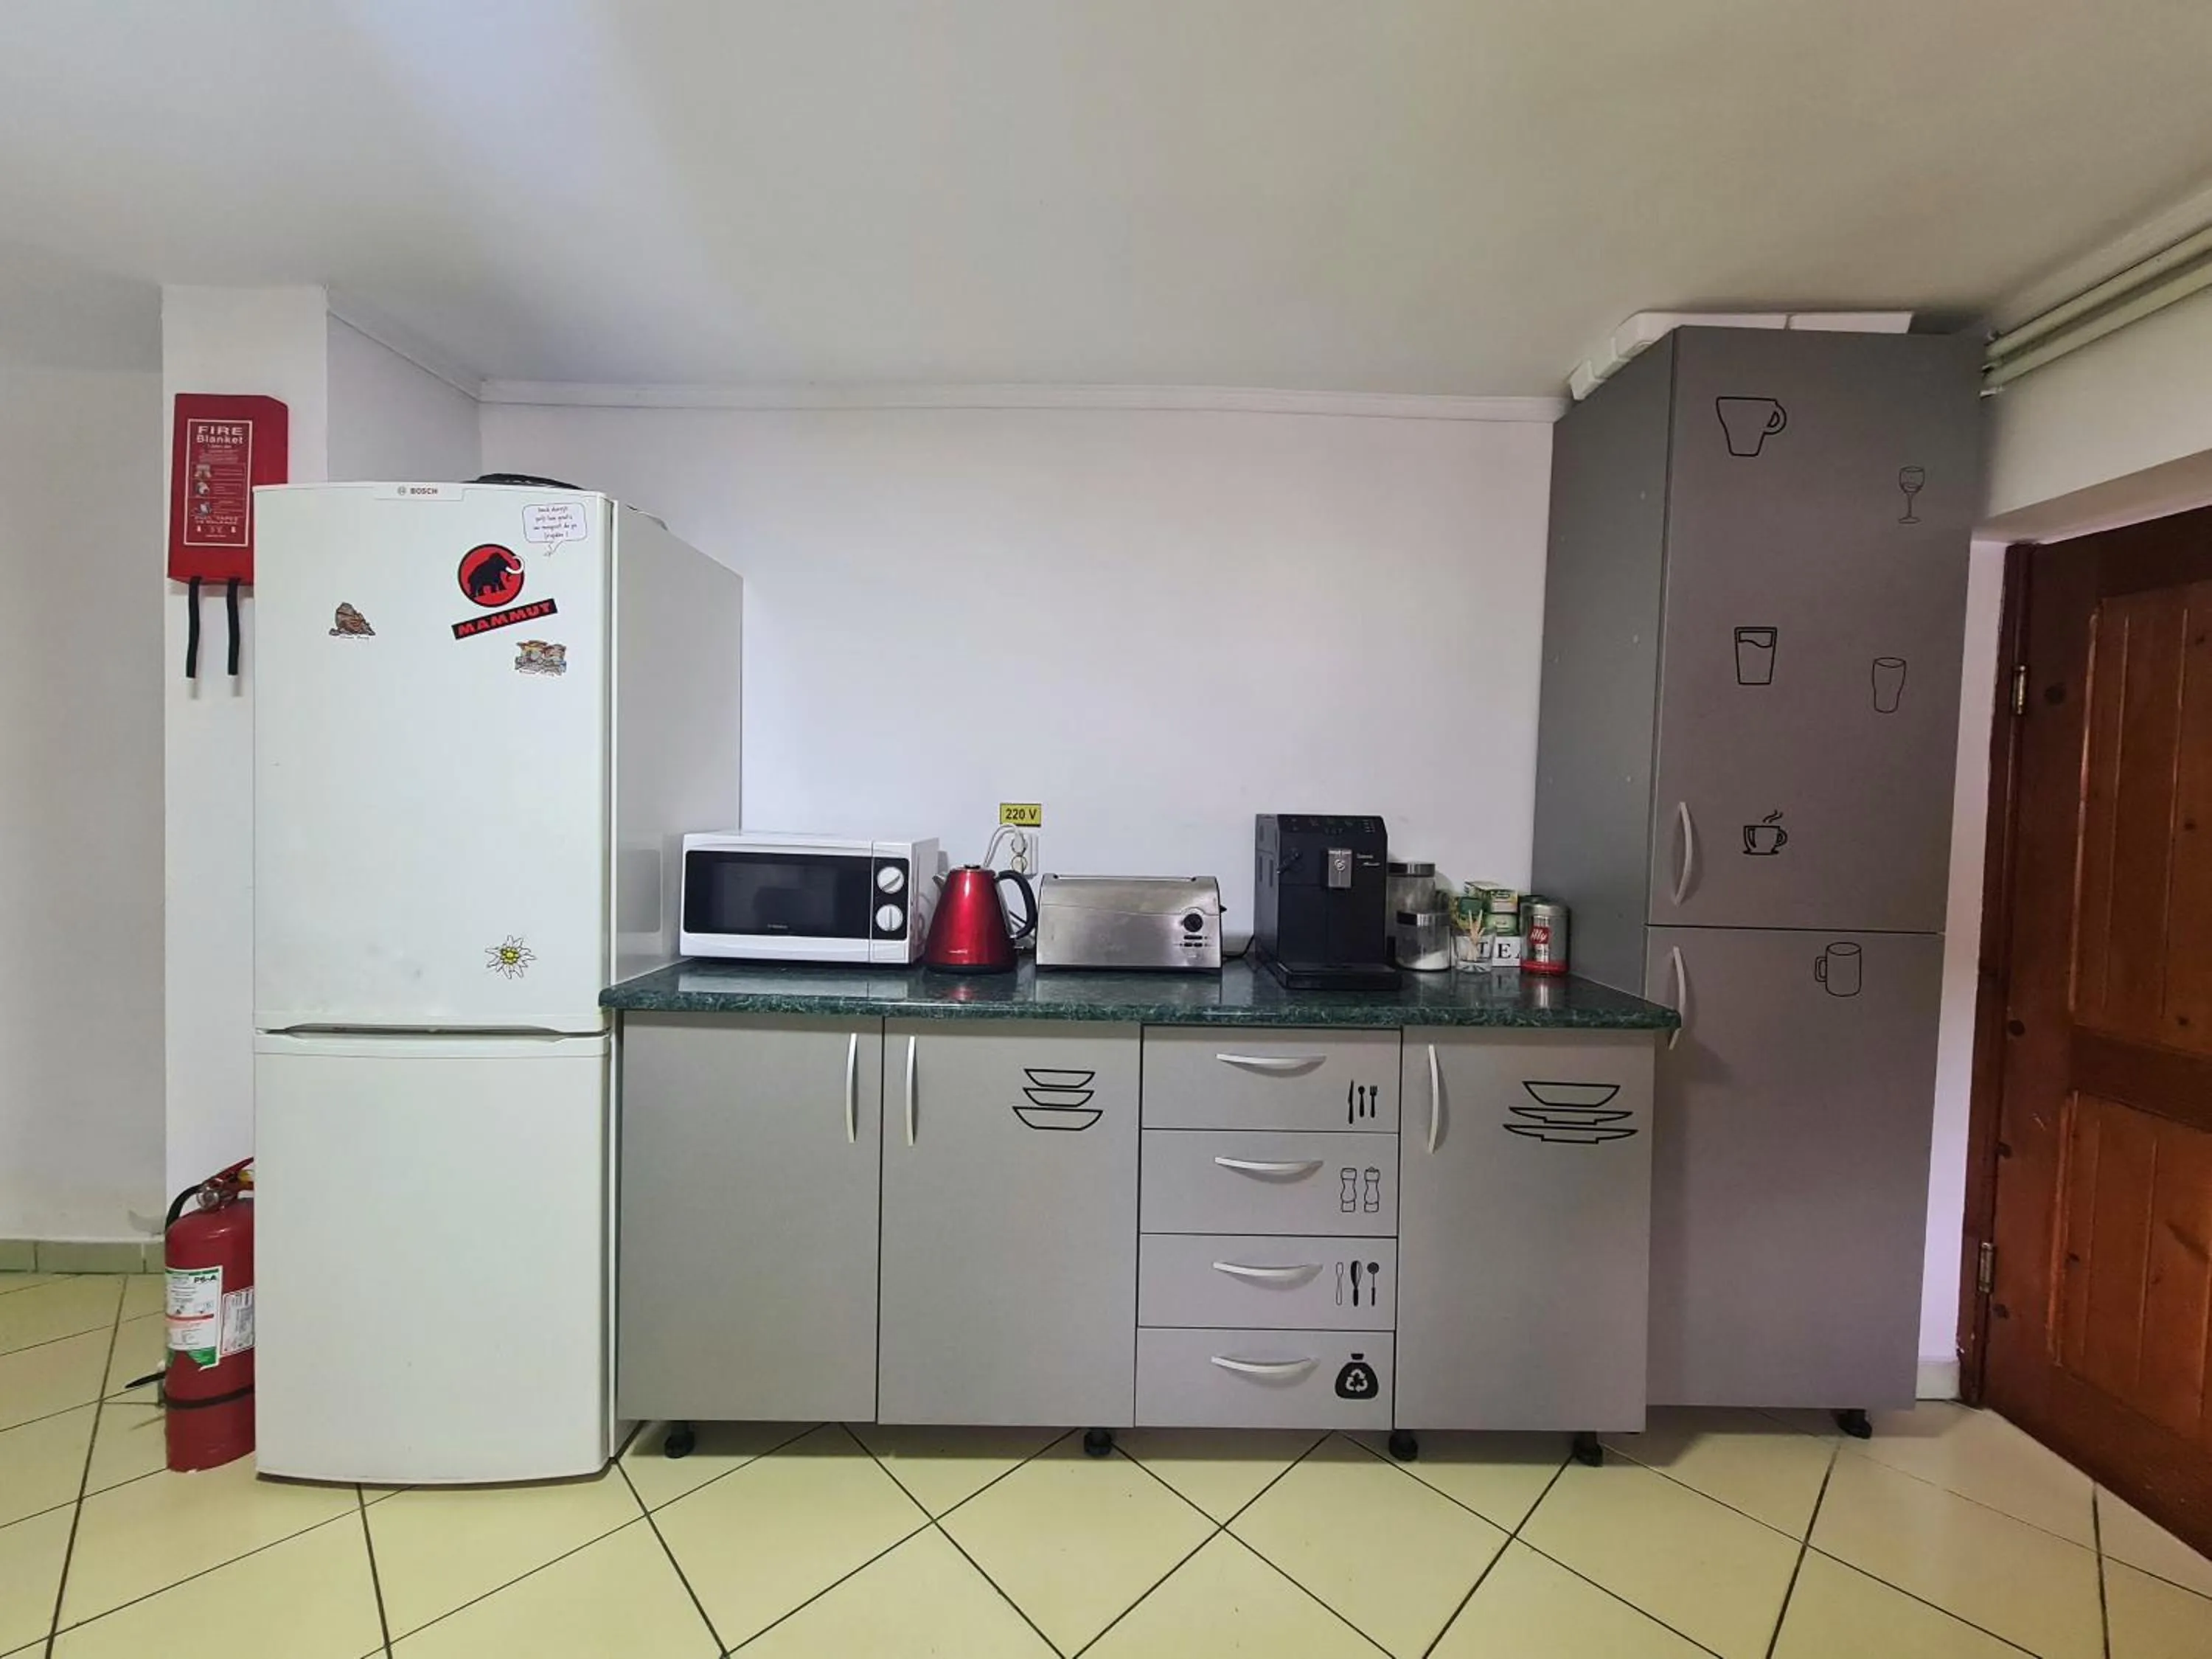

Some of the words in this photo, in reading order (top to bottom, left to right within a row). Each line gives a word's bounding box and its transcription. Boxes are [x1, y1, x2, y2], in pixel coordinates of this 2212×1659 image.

[198, 425, 243, 436] FIRE
[196, 434, 243, 444] Blanket
[458, 603, 550, 636] MAMMUT
[1005, 808, 1026, 820] 220
[1029, 808, 1037, 820] V
[1530, 928, 1548, 942] illy
[1478, 942, 1521, 959] TE
